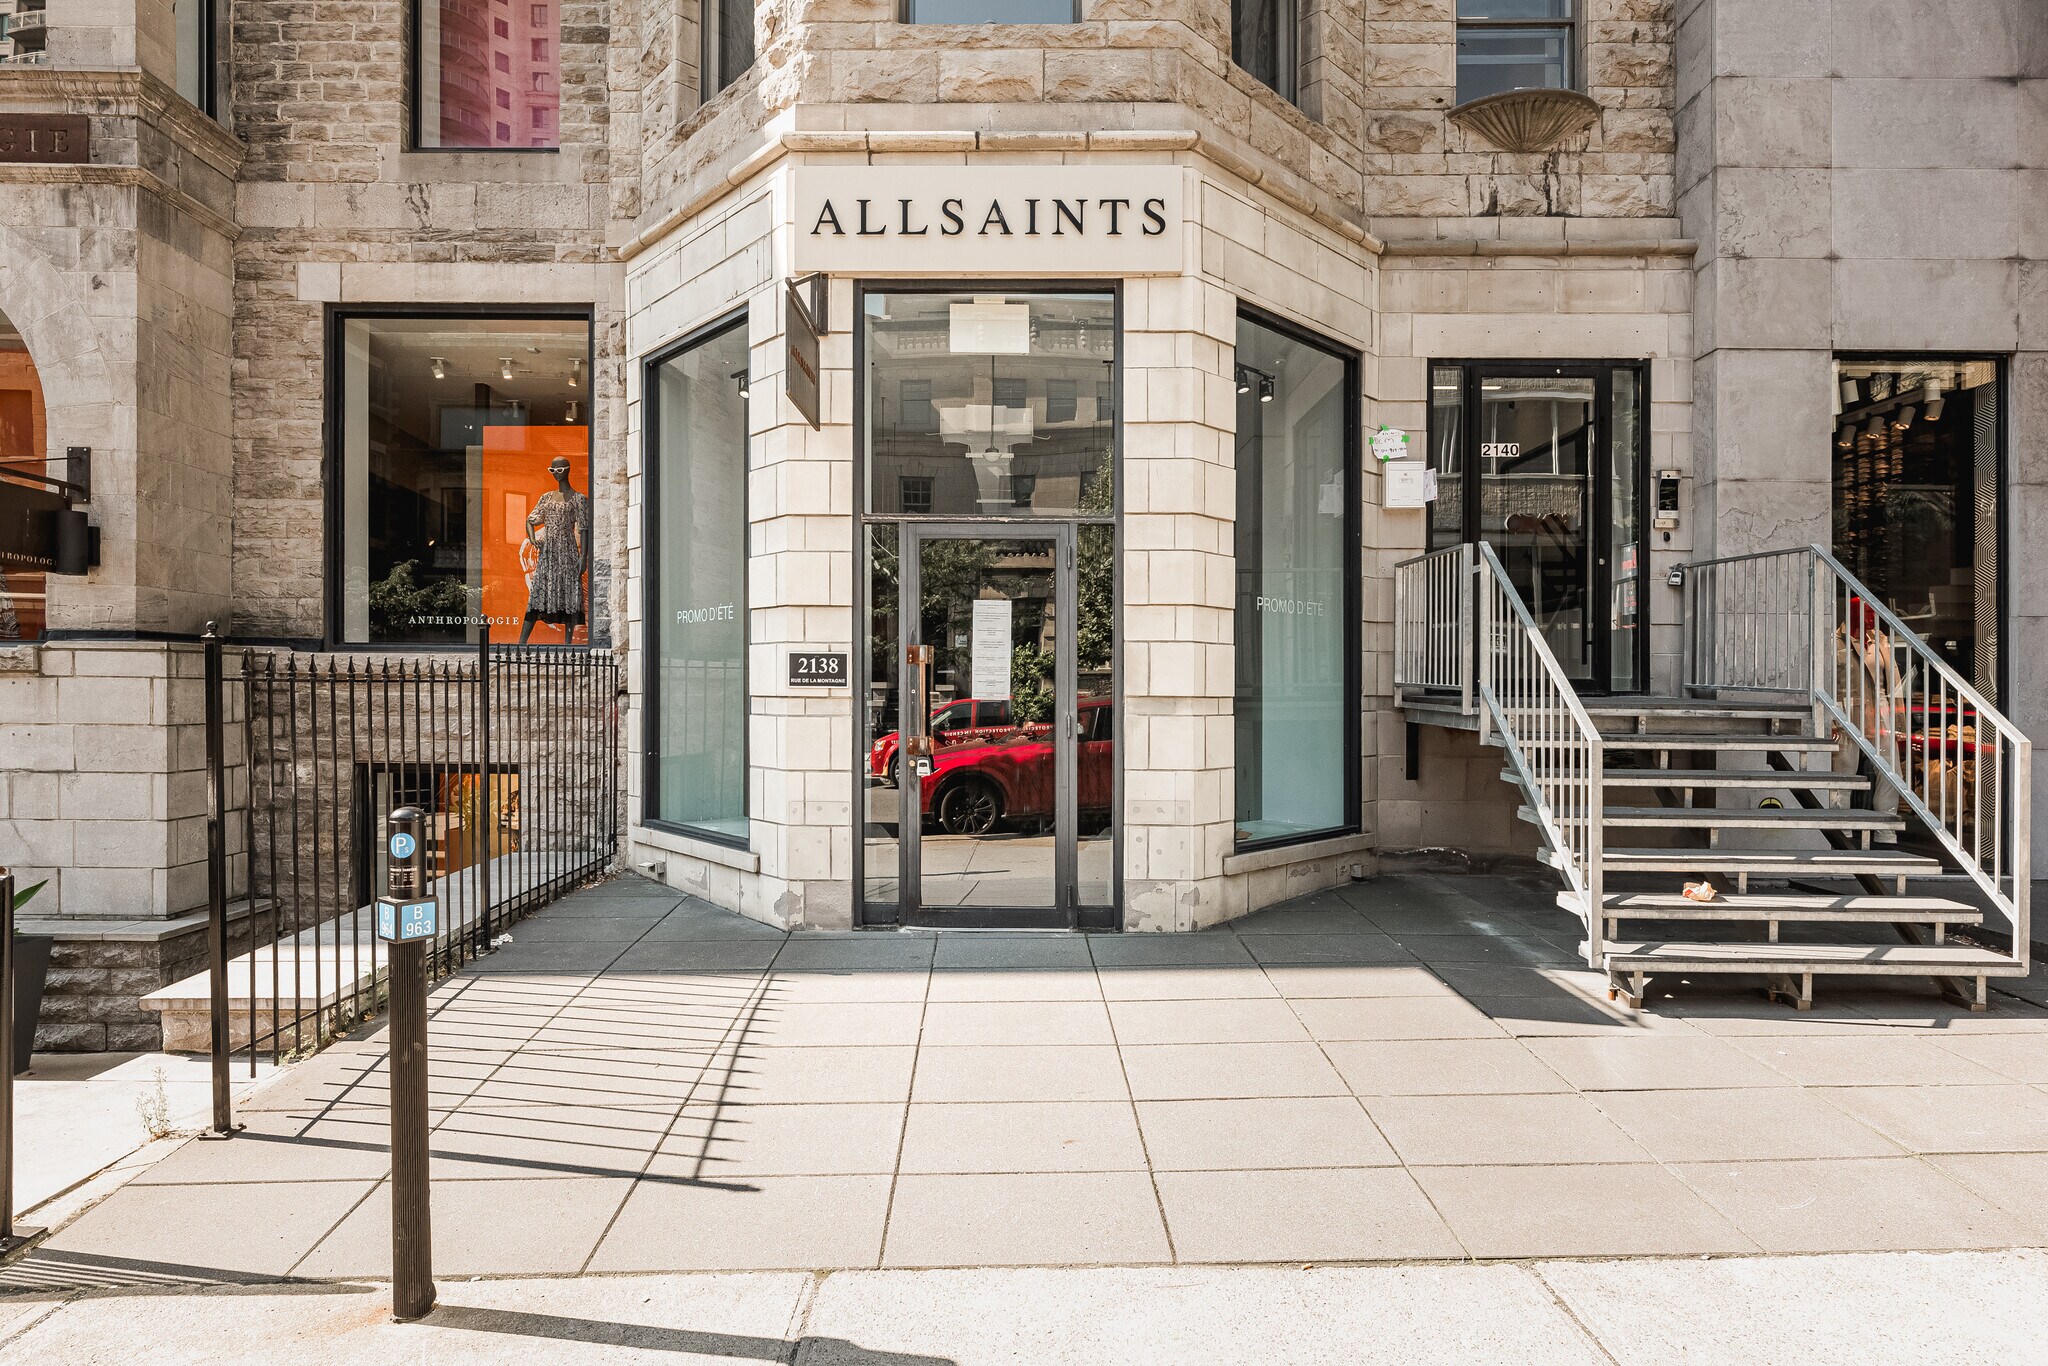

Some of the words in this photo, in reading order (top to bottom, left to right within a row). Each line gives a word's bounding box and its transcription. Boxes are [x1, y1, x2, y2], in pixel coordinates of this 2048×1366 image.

[810, 199, 1167, 236] ALLSAINTS
[1482, 444, 1519, 456] 2140
[676, 608, 708, 624] PROMO
[709, 602, 734, 621] D'ÉTÉ
[1256, 596, 1295, 614] PROMO
[1297, 599, 1324, 617] D'ÉTÉ
[408, 615, 519, 625] ANTHROPOOGIE
[797, 657, 839, 674] 2138
[384, 906, 390, 921] B
[413, 905, 423, 920] B
[405, 920, 432, 937] 963
